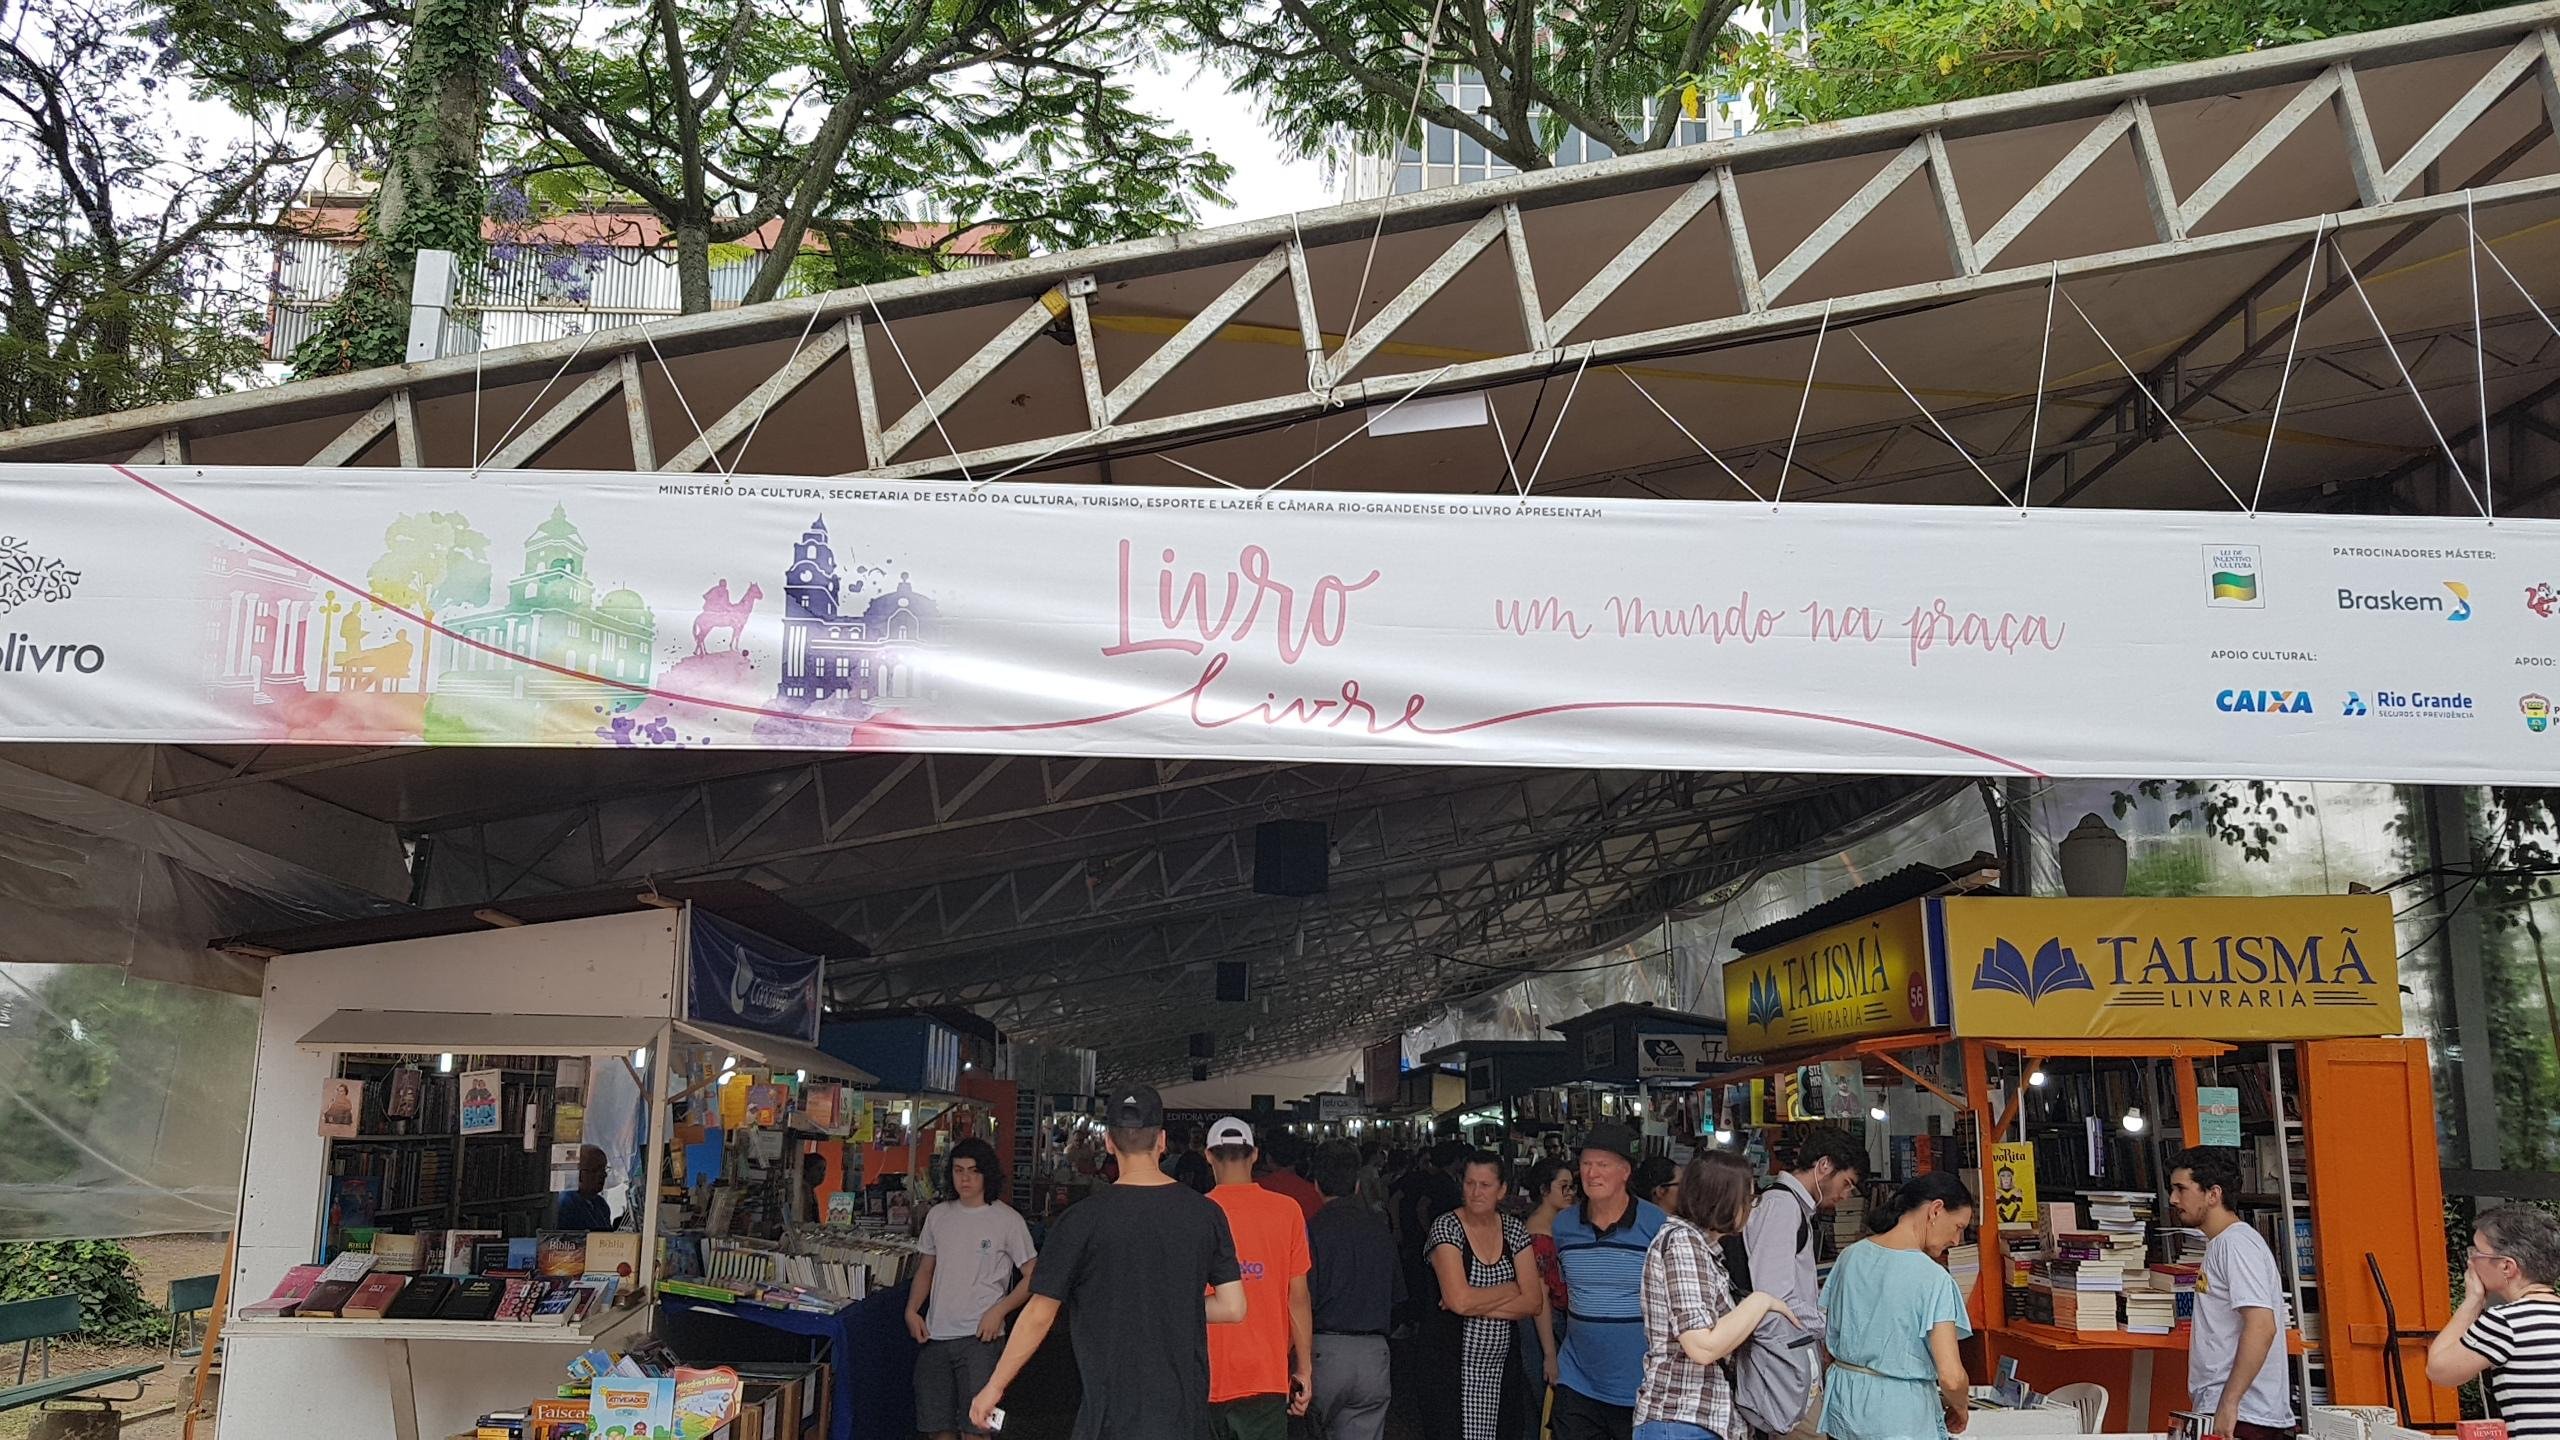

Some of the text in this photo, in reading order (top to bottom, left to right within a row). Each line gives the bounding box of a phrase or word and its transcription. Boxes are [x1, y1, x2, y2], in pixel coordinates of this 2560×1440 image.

[658, 484, 1602, 518] MINISTÉRIO DA CULTURA, SECRETARIA DE ESTADO DA CULTURA, TURISMO, ESPORTE E LAZER E CÂMARA RIO-GRANDENSE DO LIVRO APRESENTAM
[2333, 547, 2496, 560] PATROCINADORES MÁSTER:
[1101, 538, 1381, 665] Livro
[2337, 588, 2444, 612] Braskem
[1494, 590, 2067, 667] um mundo na praça
[0, 633, 105, 674] livro
[2210, 650, 2318, 662] APOIO CULTURAL:
[2514, 657, 2557, 666] APOIO:
[2215, 689, 2314, 714] CAIXA
[2377, 691, 2473, 709] Rio Grande
[2423, 711, 2475, 719] PREVIDÊNCIA
[1782, 921, 1891, 1011] TALISMÃ
[2096, 926, 2379, 985] TALISMÃ
[1910, 985, 1924, 1007] 56
[2170, 989, 2307, 1008] LIVRARIA
[1809, 1004, 1863, 1034] LIVRARIA
[1993, 1148, 2026, 1163] voRita
